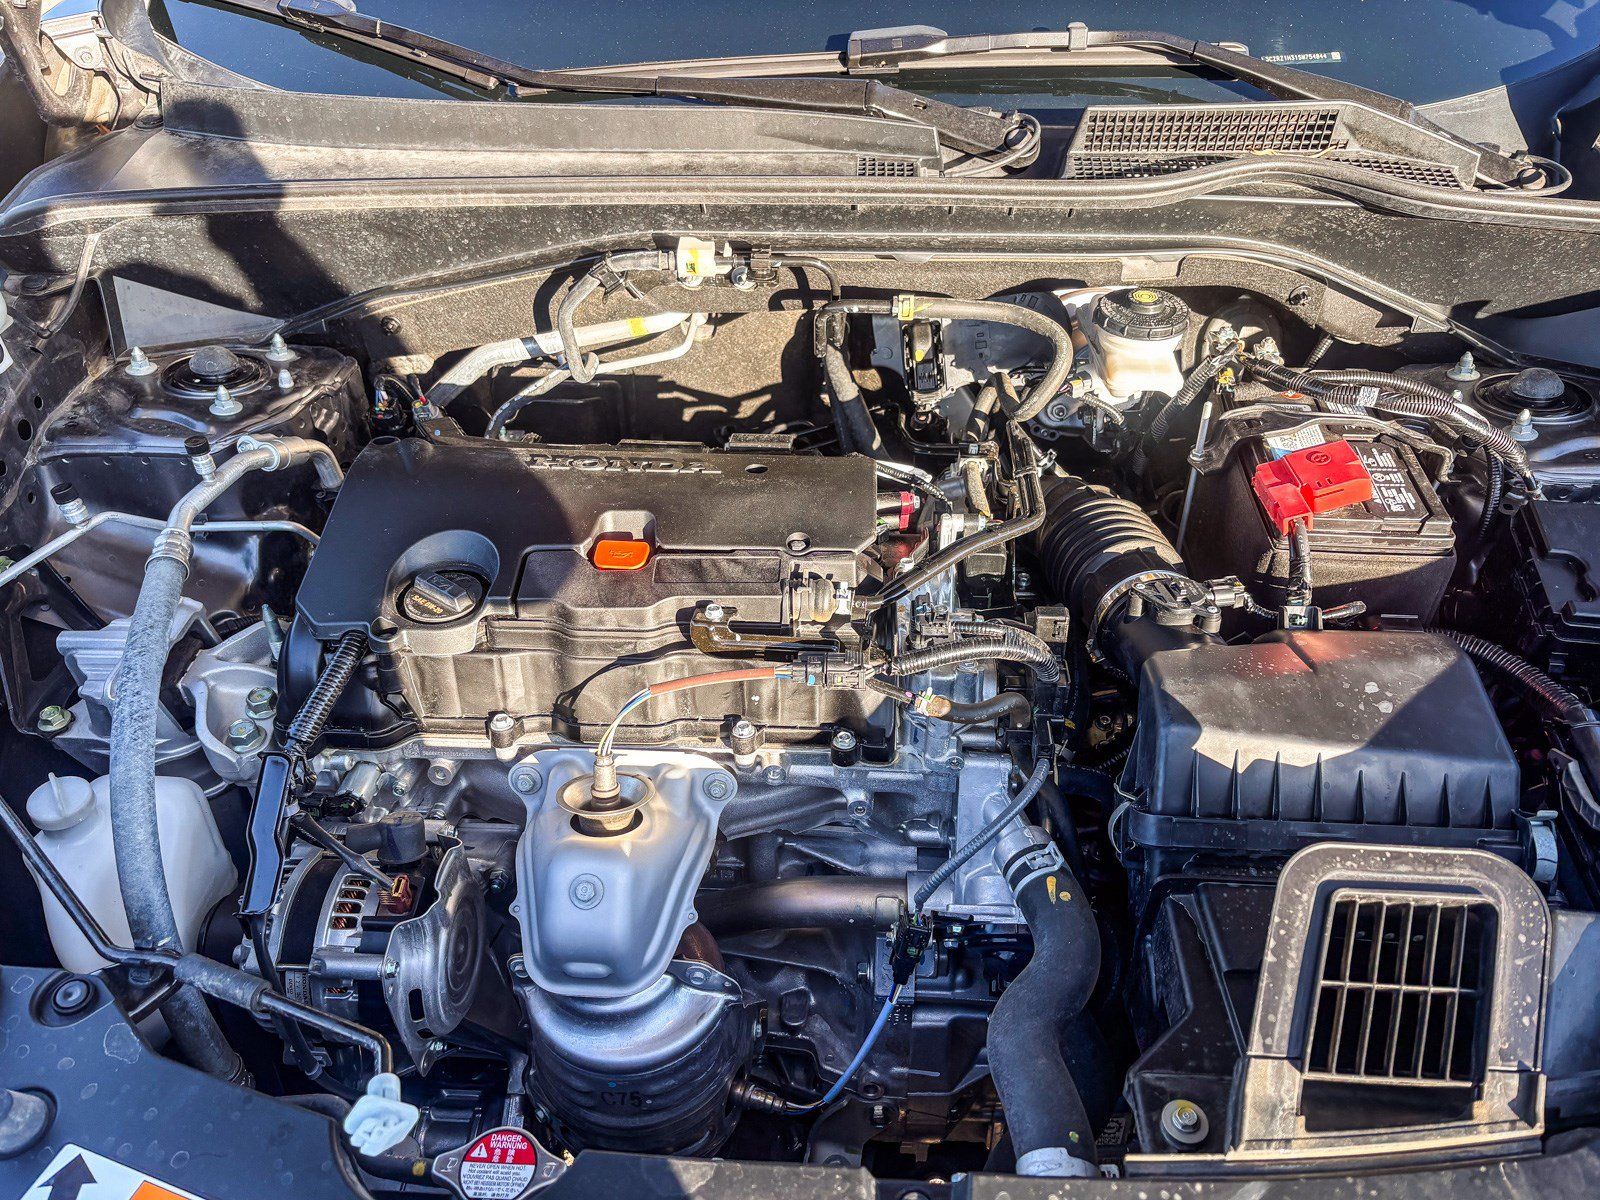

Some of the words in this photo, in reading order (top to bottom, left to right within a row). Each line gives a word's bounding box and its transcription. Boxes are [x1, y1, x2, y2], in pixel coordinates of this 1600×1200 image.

[525, 453, 722, 475] HONDA
[491, 1133, 522, 1142] DANGER
[490, 1141, 528, 1149] WARNUNG
